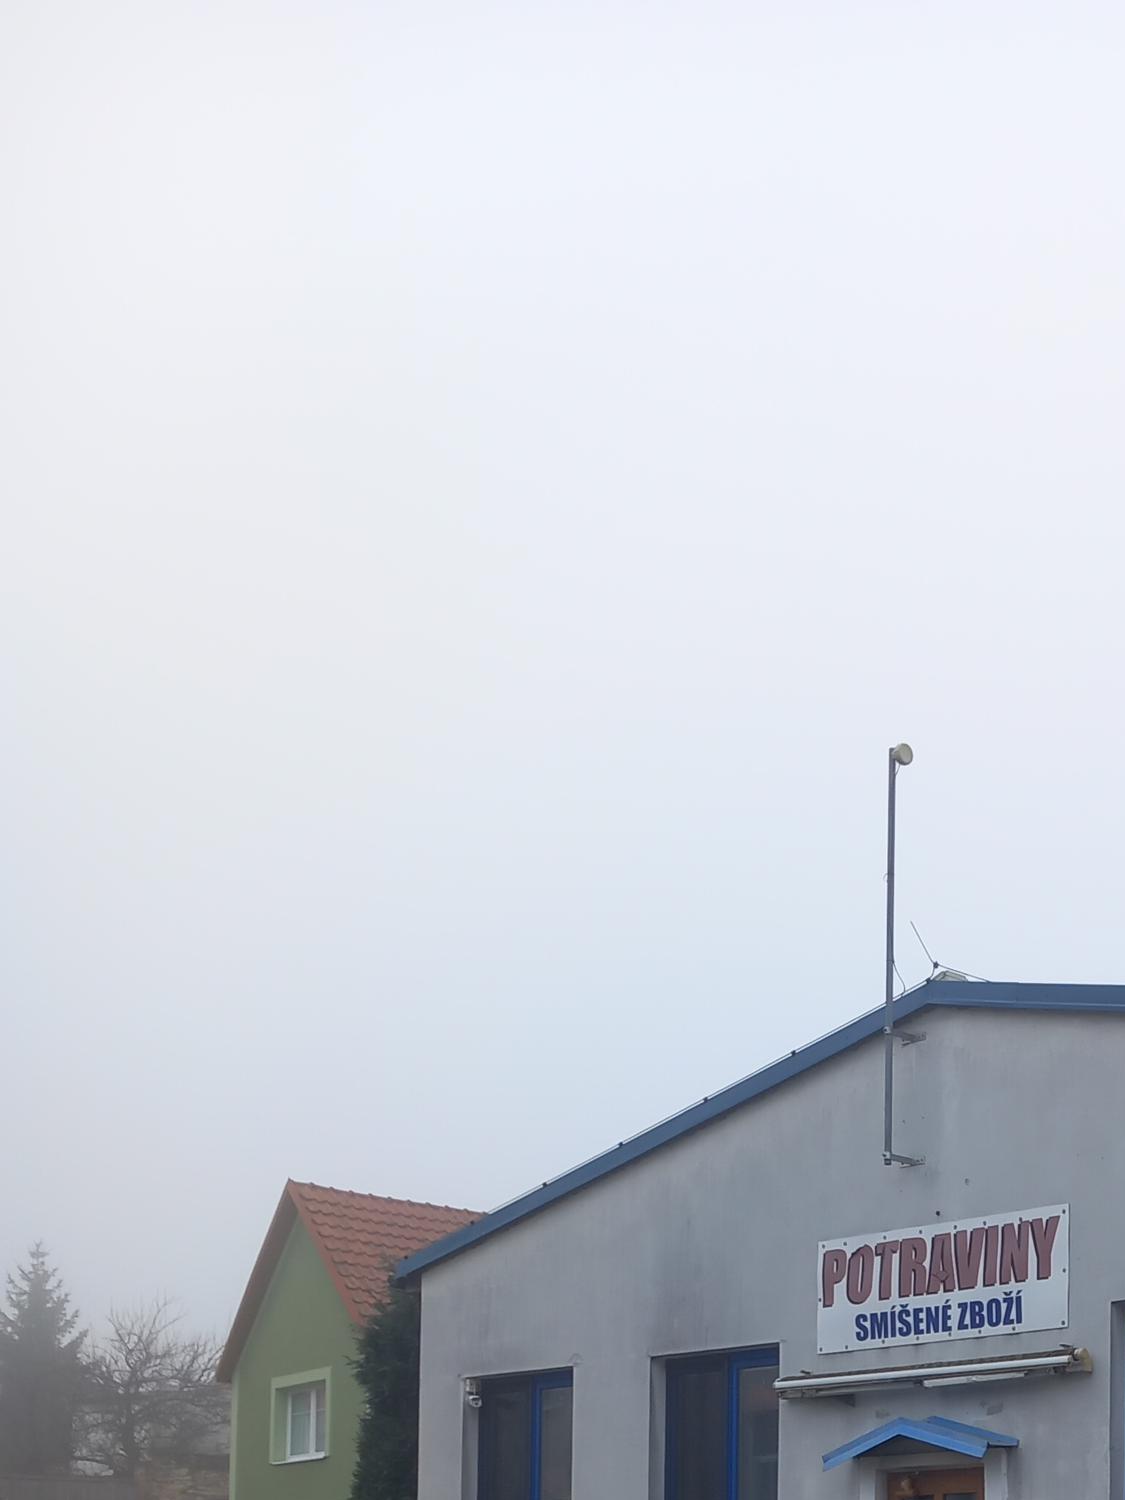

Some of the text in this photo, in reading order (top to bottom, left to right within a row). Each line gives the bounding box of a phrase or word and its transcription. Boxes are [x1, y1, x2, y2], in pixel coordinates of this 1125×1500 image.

[822, 1215, 1060, 1308] POTRAVINY
[855, 1290, 1023, 1341] SMÍŠENÉ ZBOŽÍ
